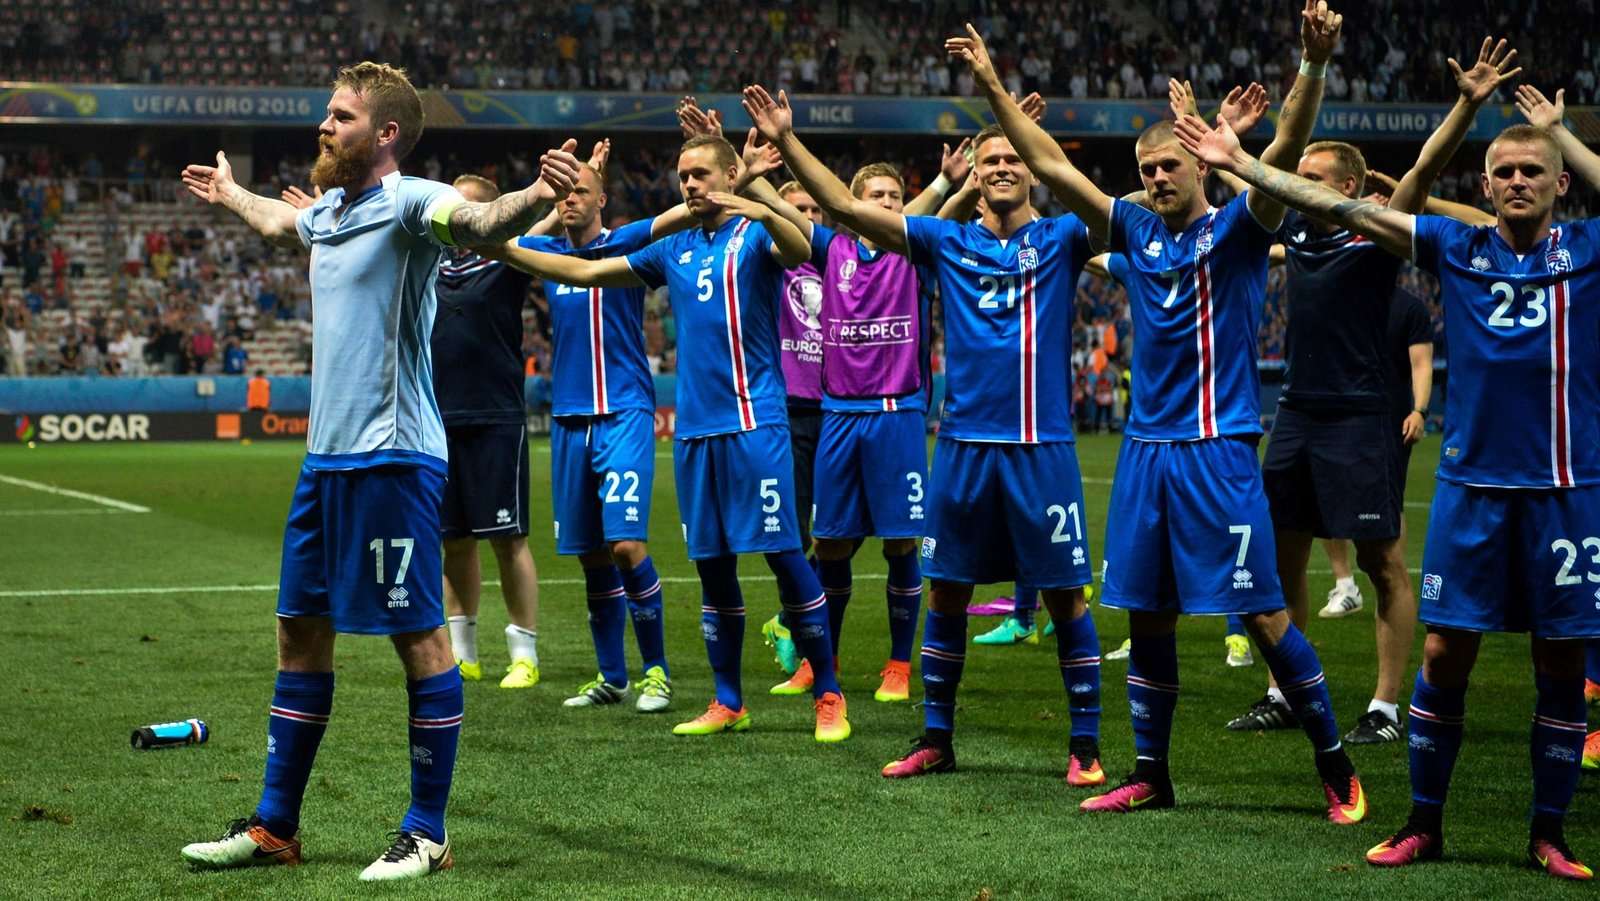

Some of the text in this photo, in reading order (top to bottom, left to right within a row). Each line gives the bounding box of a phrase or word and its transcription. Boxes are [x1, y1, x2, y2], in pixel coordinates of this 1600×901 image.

[133, 96, 311, 116] UEFA EURO 2016
[809, 105, 854, 123] NICE
[1322, 112, 1373, 130] UEFA
[1376, 113, 1427, 131] EURO
[696, 267, 714, 302] 5
[978, 275, 1016, 309] 21
[1160, 271, 1180, 309] 7
[1488, 281, 1547, 328] 23
[840, 321, 912, 341] RESPECT
[39, 413, 150, 441] SOCAR
[262, 414, 308, 434] Oran
[605, 471, 640, 503] 22
[760, 478, 781, 513] 5
[906, 471, 924, 503] 3
[1046, 502, 1082, 543] 21
[369, 538, 415, 584] 17
[1229, 525, 1252, 567] 7
[1551, 537, 1600, 586] 23
